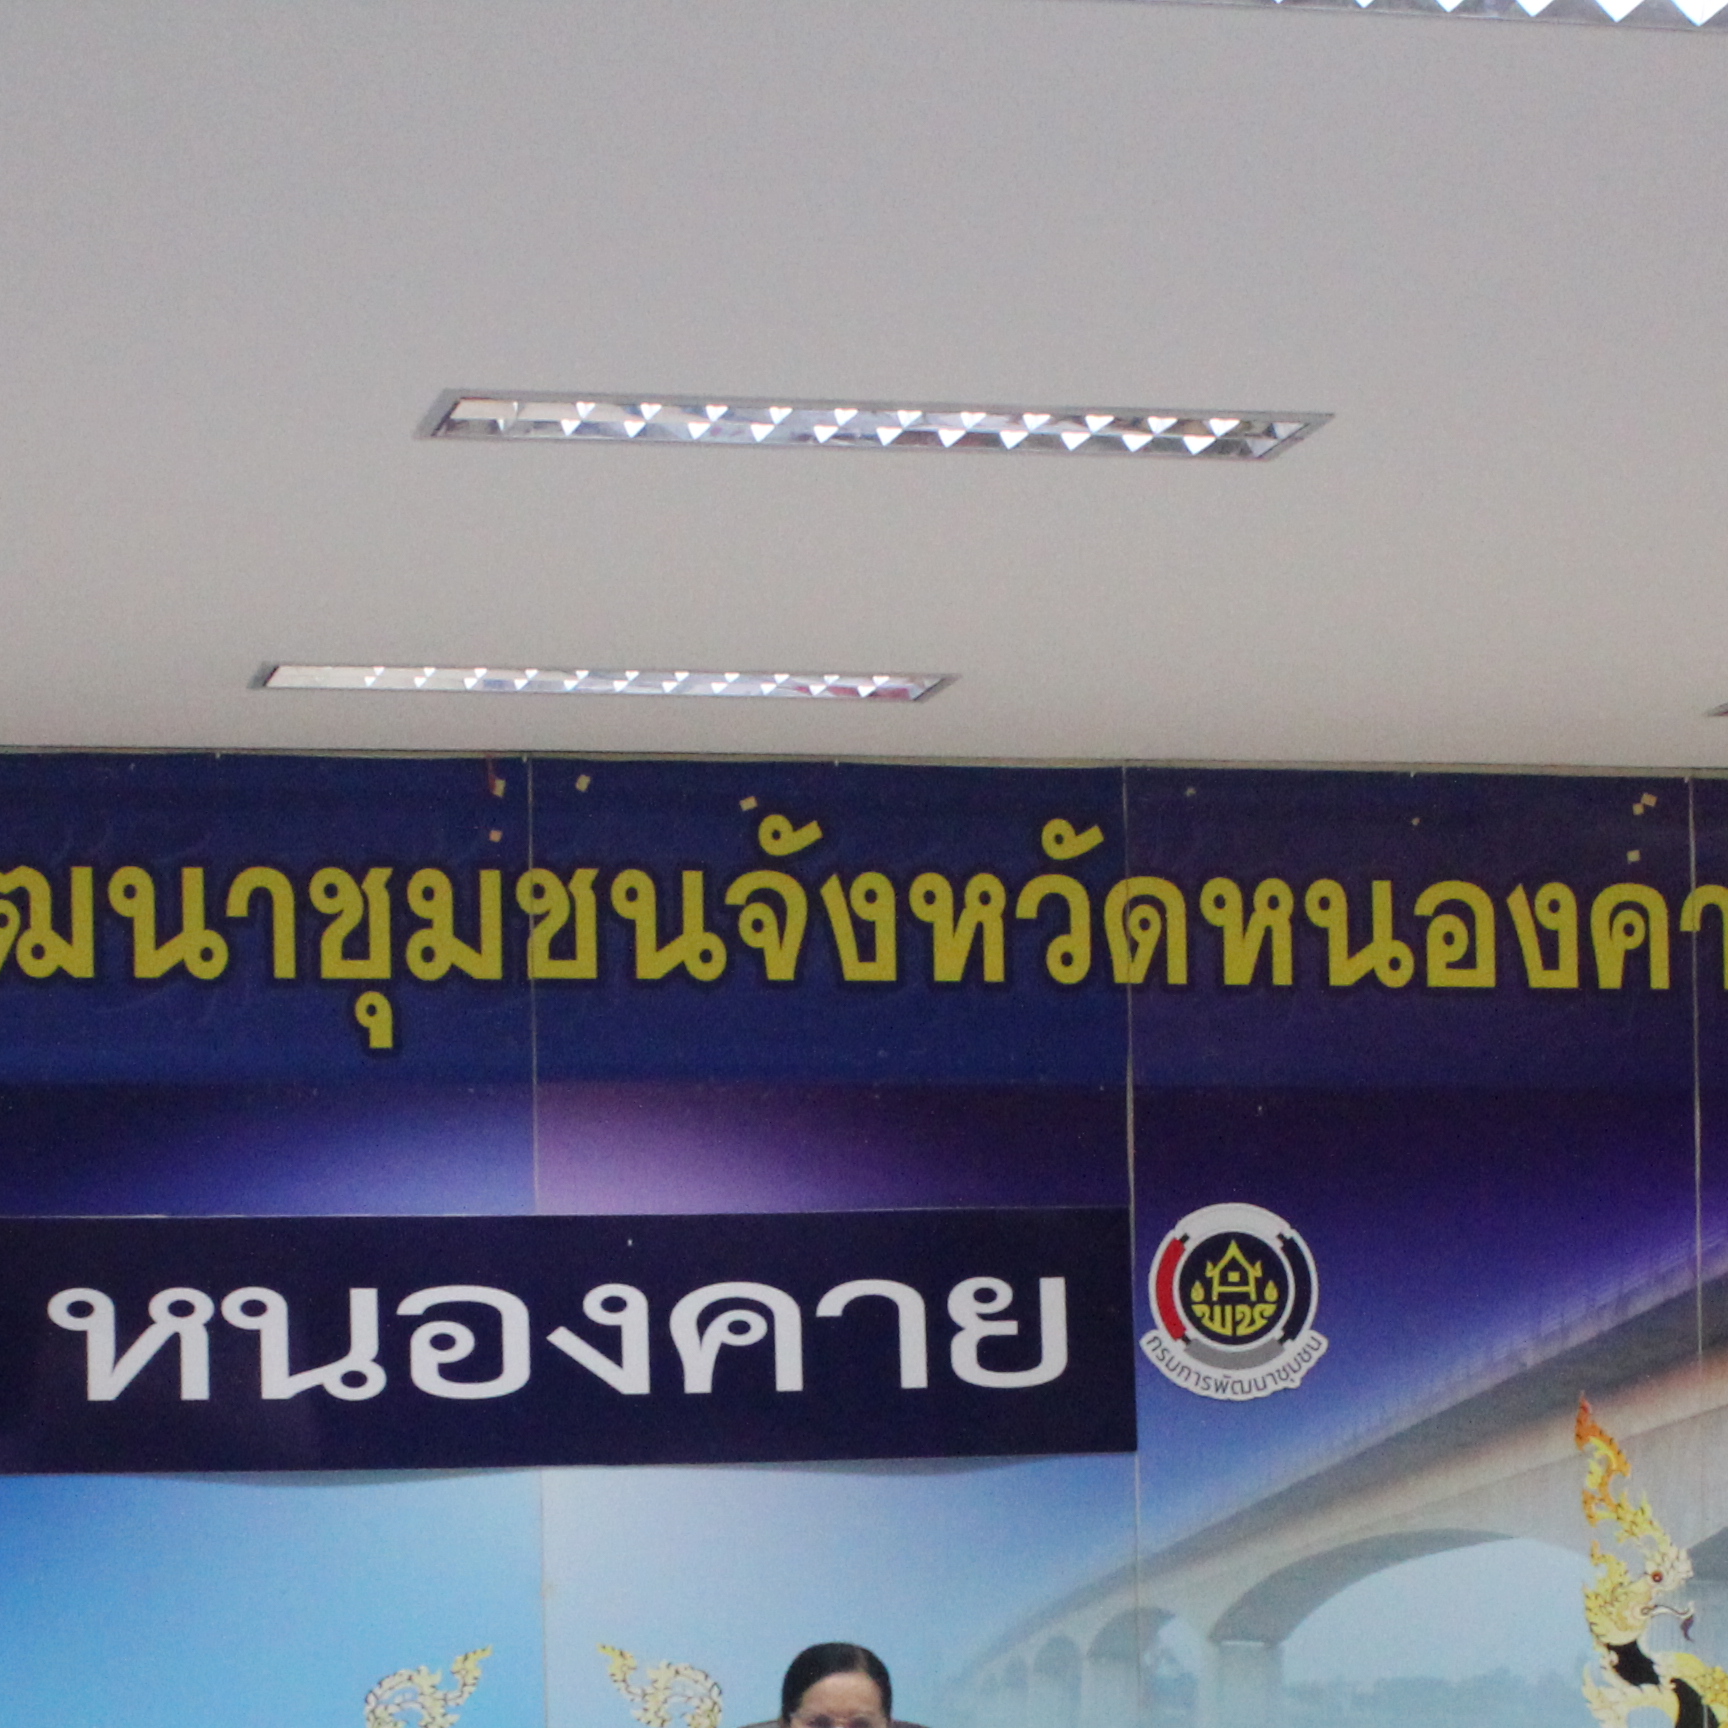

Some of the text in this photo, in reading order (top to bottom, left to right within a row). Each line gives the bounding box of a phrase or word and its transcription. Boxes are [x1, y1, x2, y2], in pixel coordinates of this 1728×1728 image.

[46, 1275, 1069, 1402] หนองคาย
[1145, 1334, 1323, 1395] กรมการพัฒนาชุมชน
